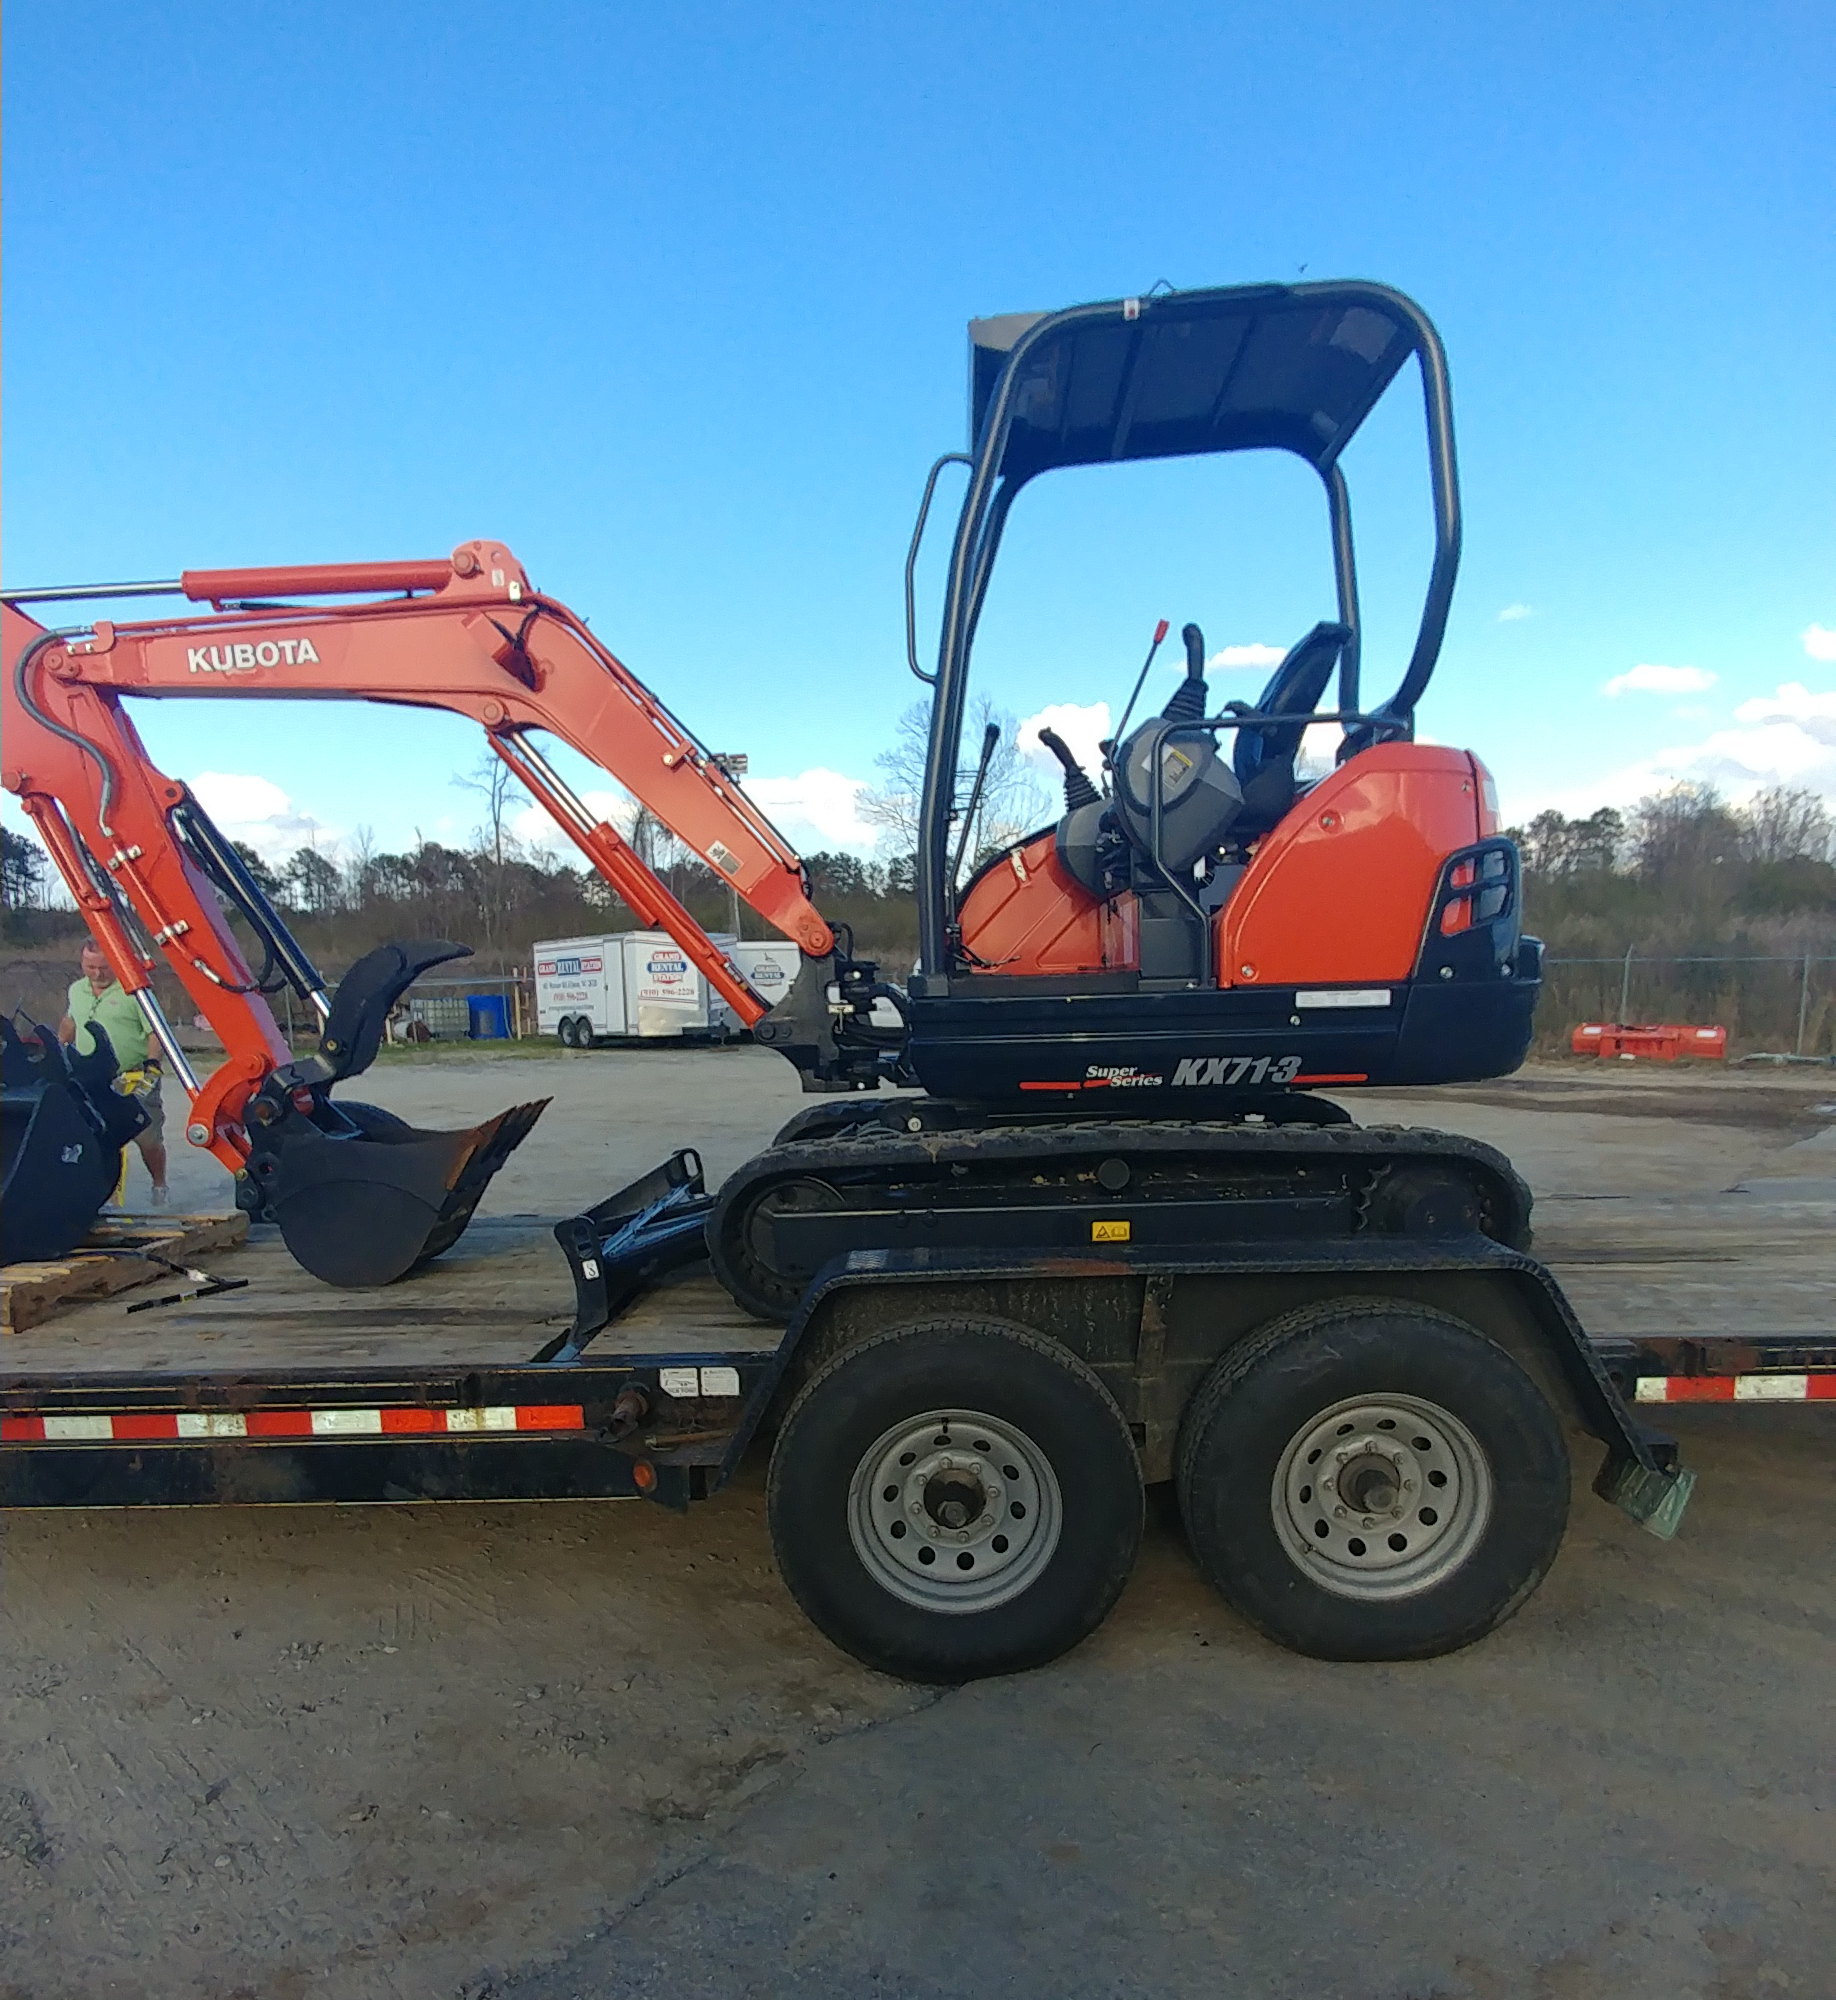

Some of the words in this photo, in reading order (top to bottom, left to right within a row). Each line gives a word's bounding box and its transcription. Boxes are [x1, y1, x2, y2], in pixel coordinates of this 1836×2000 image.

[187, 638, 319, 673] KUBOTA
[557, 960, 580, 974] RENTAL
[651, 962, 684, 971] RENTAL
[1086, 1065, 1138, 1079] Super
[1171, 1056, 1302, 1086] KX71-3
[1110, 1075, 1163, 1088] Series
